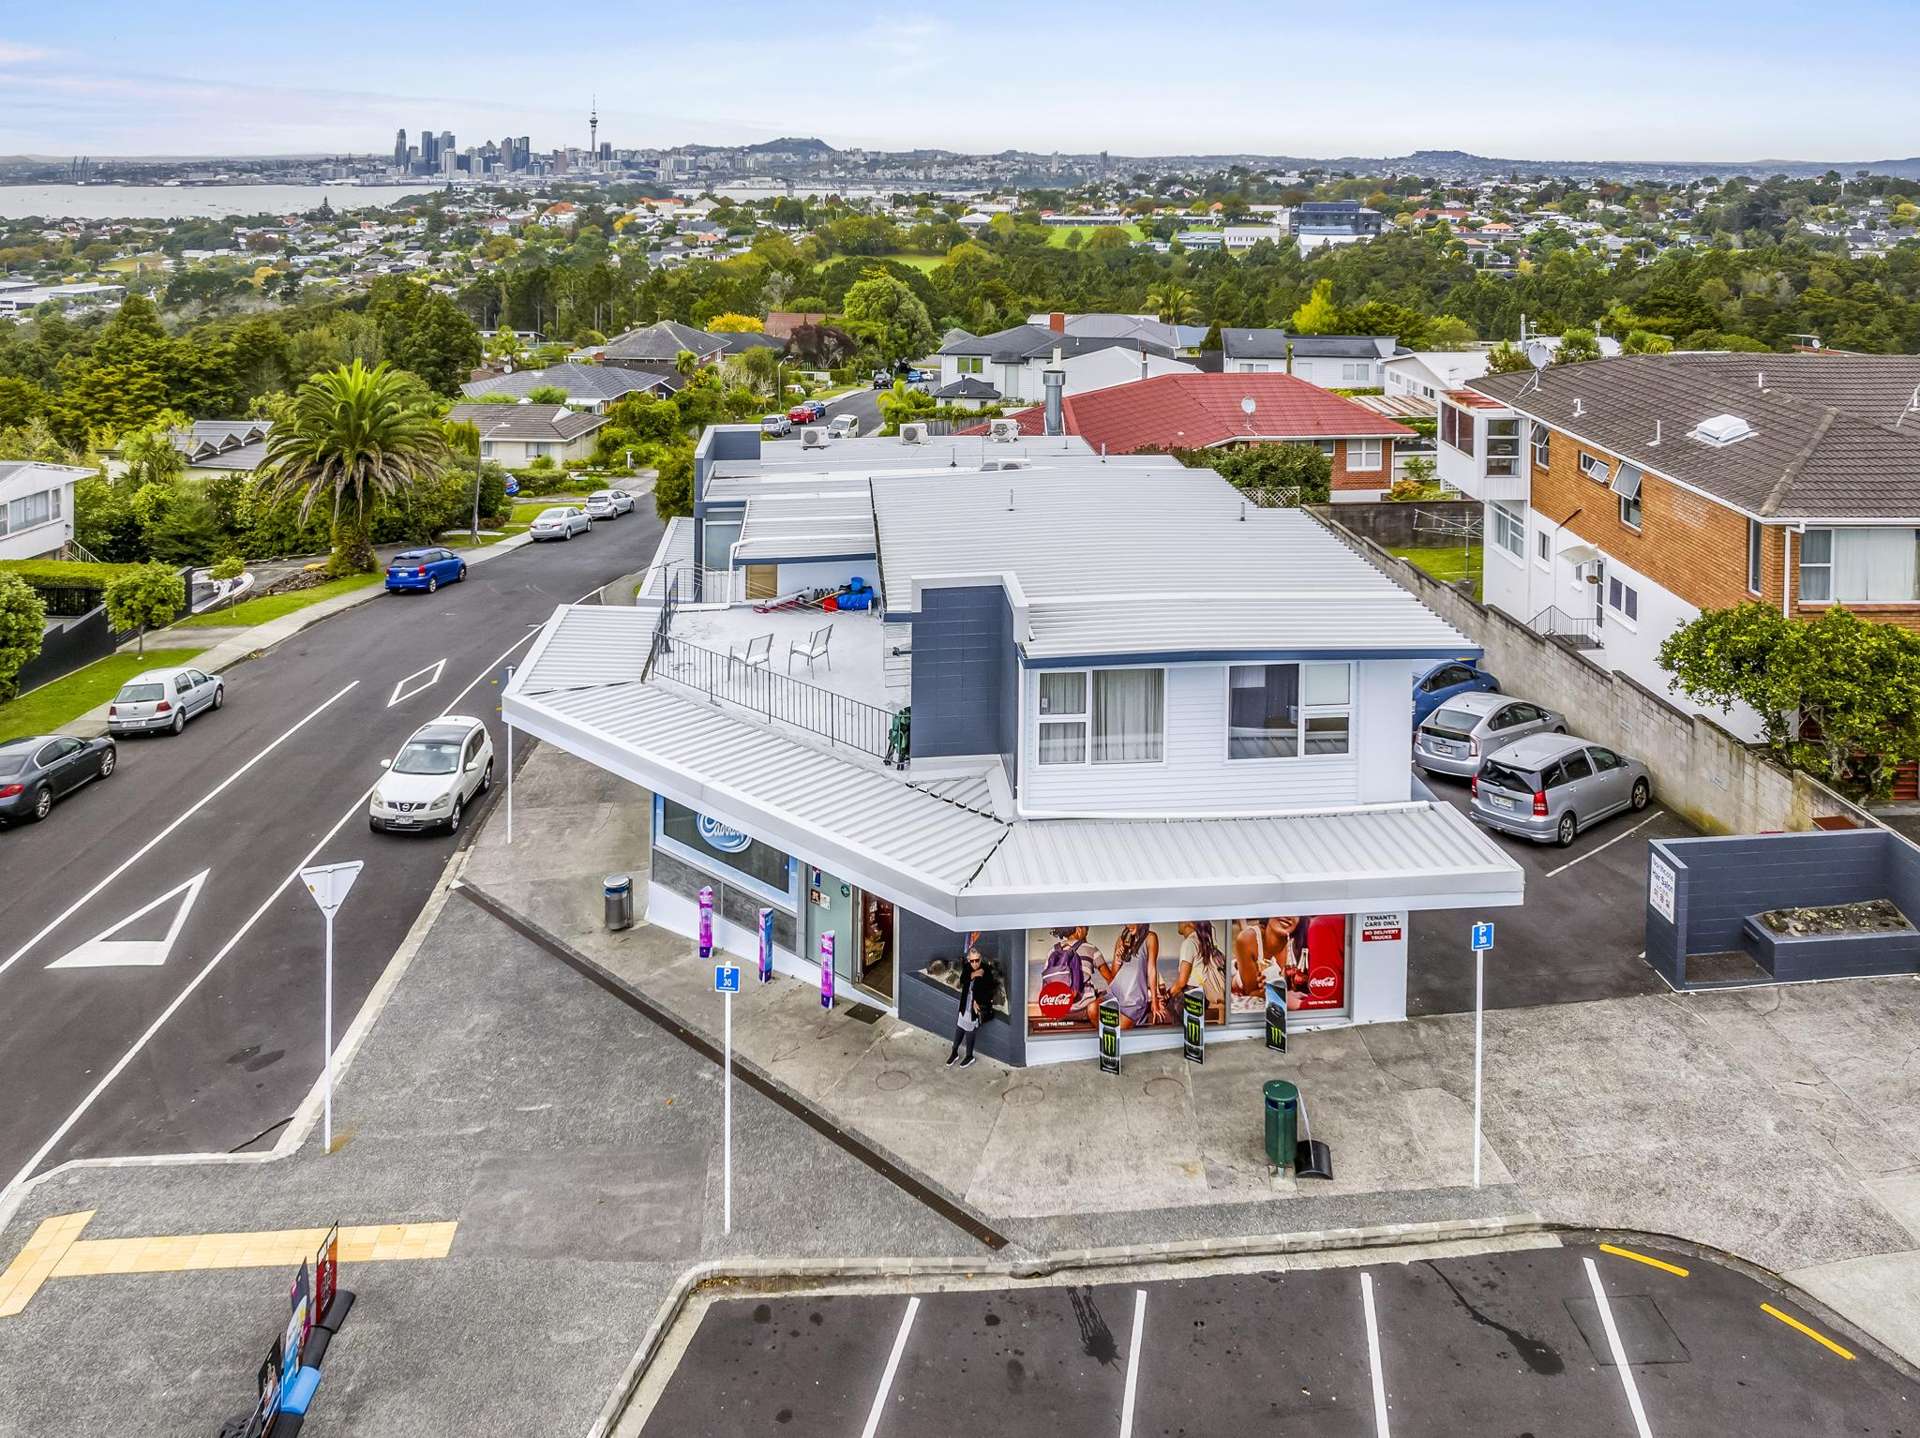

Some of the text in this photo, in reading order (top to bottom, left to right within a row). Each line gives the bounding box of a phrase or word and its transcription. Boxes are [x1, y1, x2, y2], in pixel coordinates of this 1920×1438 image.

[1479, 926, 1487, 936] P
[723, 968, 731, 978] P
[1040, 993, 1071, 1006] Coca-Cola
